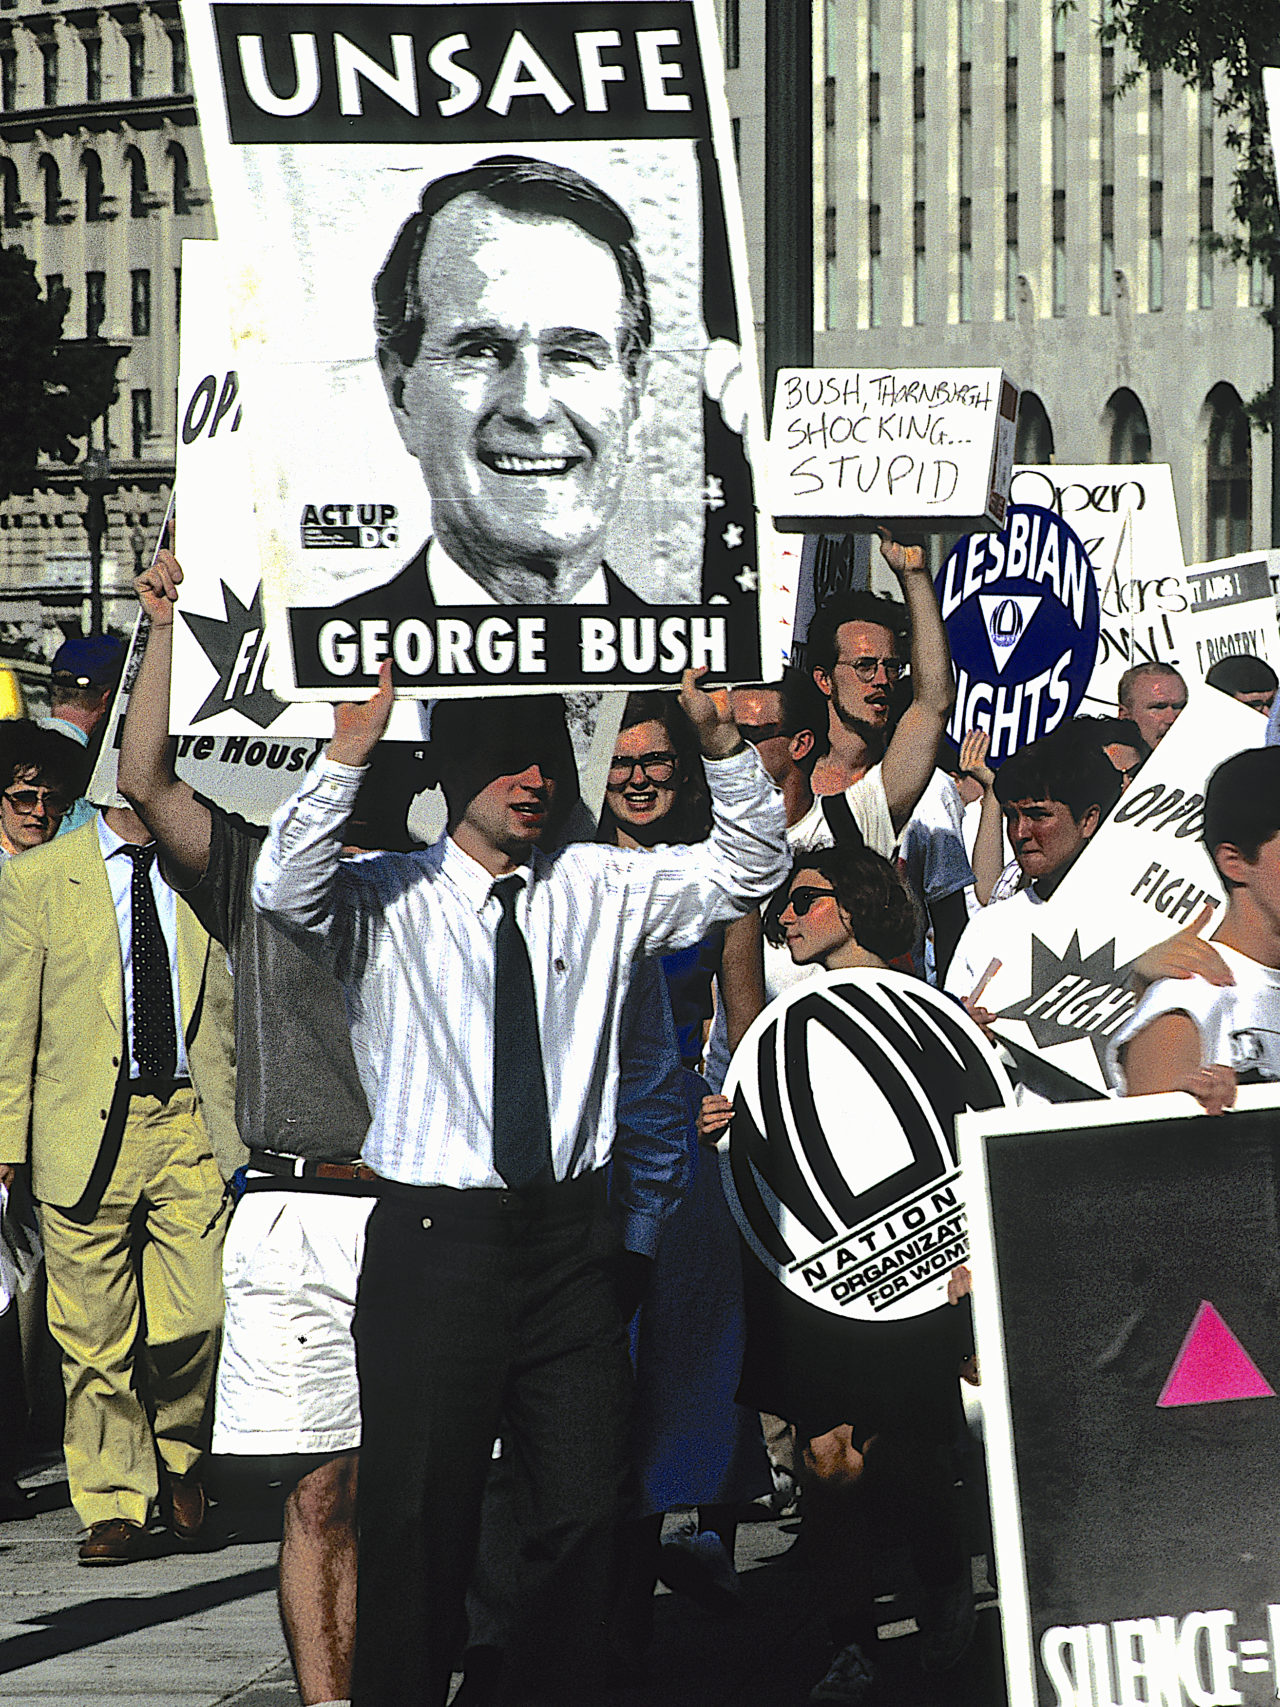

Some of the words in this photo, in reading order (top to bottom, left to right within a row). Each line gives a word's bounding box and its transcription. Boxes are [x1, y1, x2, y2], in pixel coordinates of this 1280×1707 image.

[237, 29, 693, 118] UNSAFE
[301, 504, 354, 526] ACT
[357, 504, 399, 526] UP
[790, 455, 959, 505] STUPID
[361, 527, 400, 549] DC
[942, 512, 1088, 631] LESBIAN
[318, 617, 548, 677] GEORGE
[580, 617, 729, 675] BUSH
[946, 648, 1072, 757] IGHTS
[729, 982, 1006, 1267] NOW
[801, 1187, 958, 1287] NATION
[867, 1275, 910, 1307] FOR
